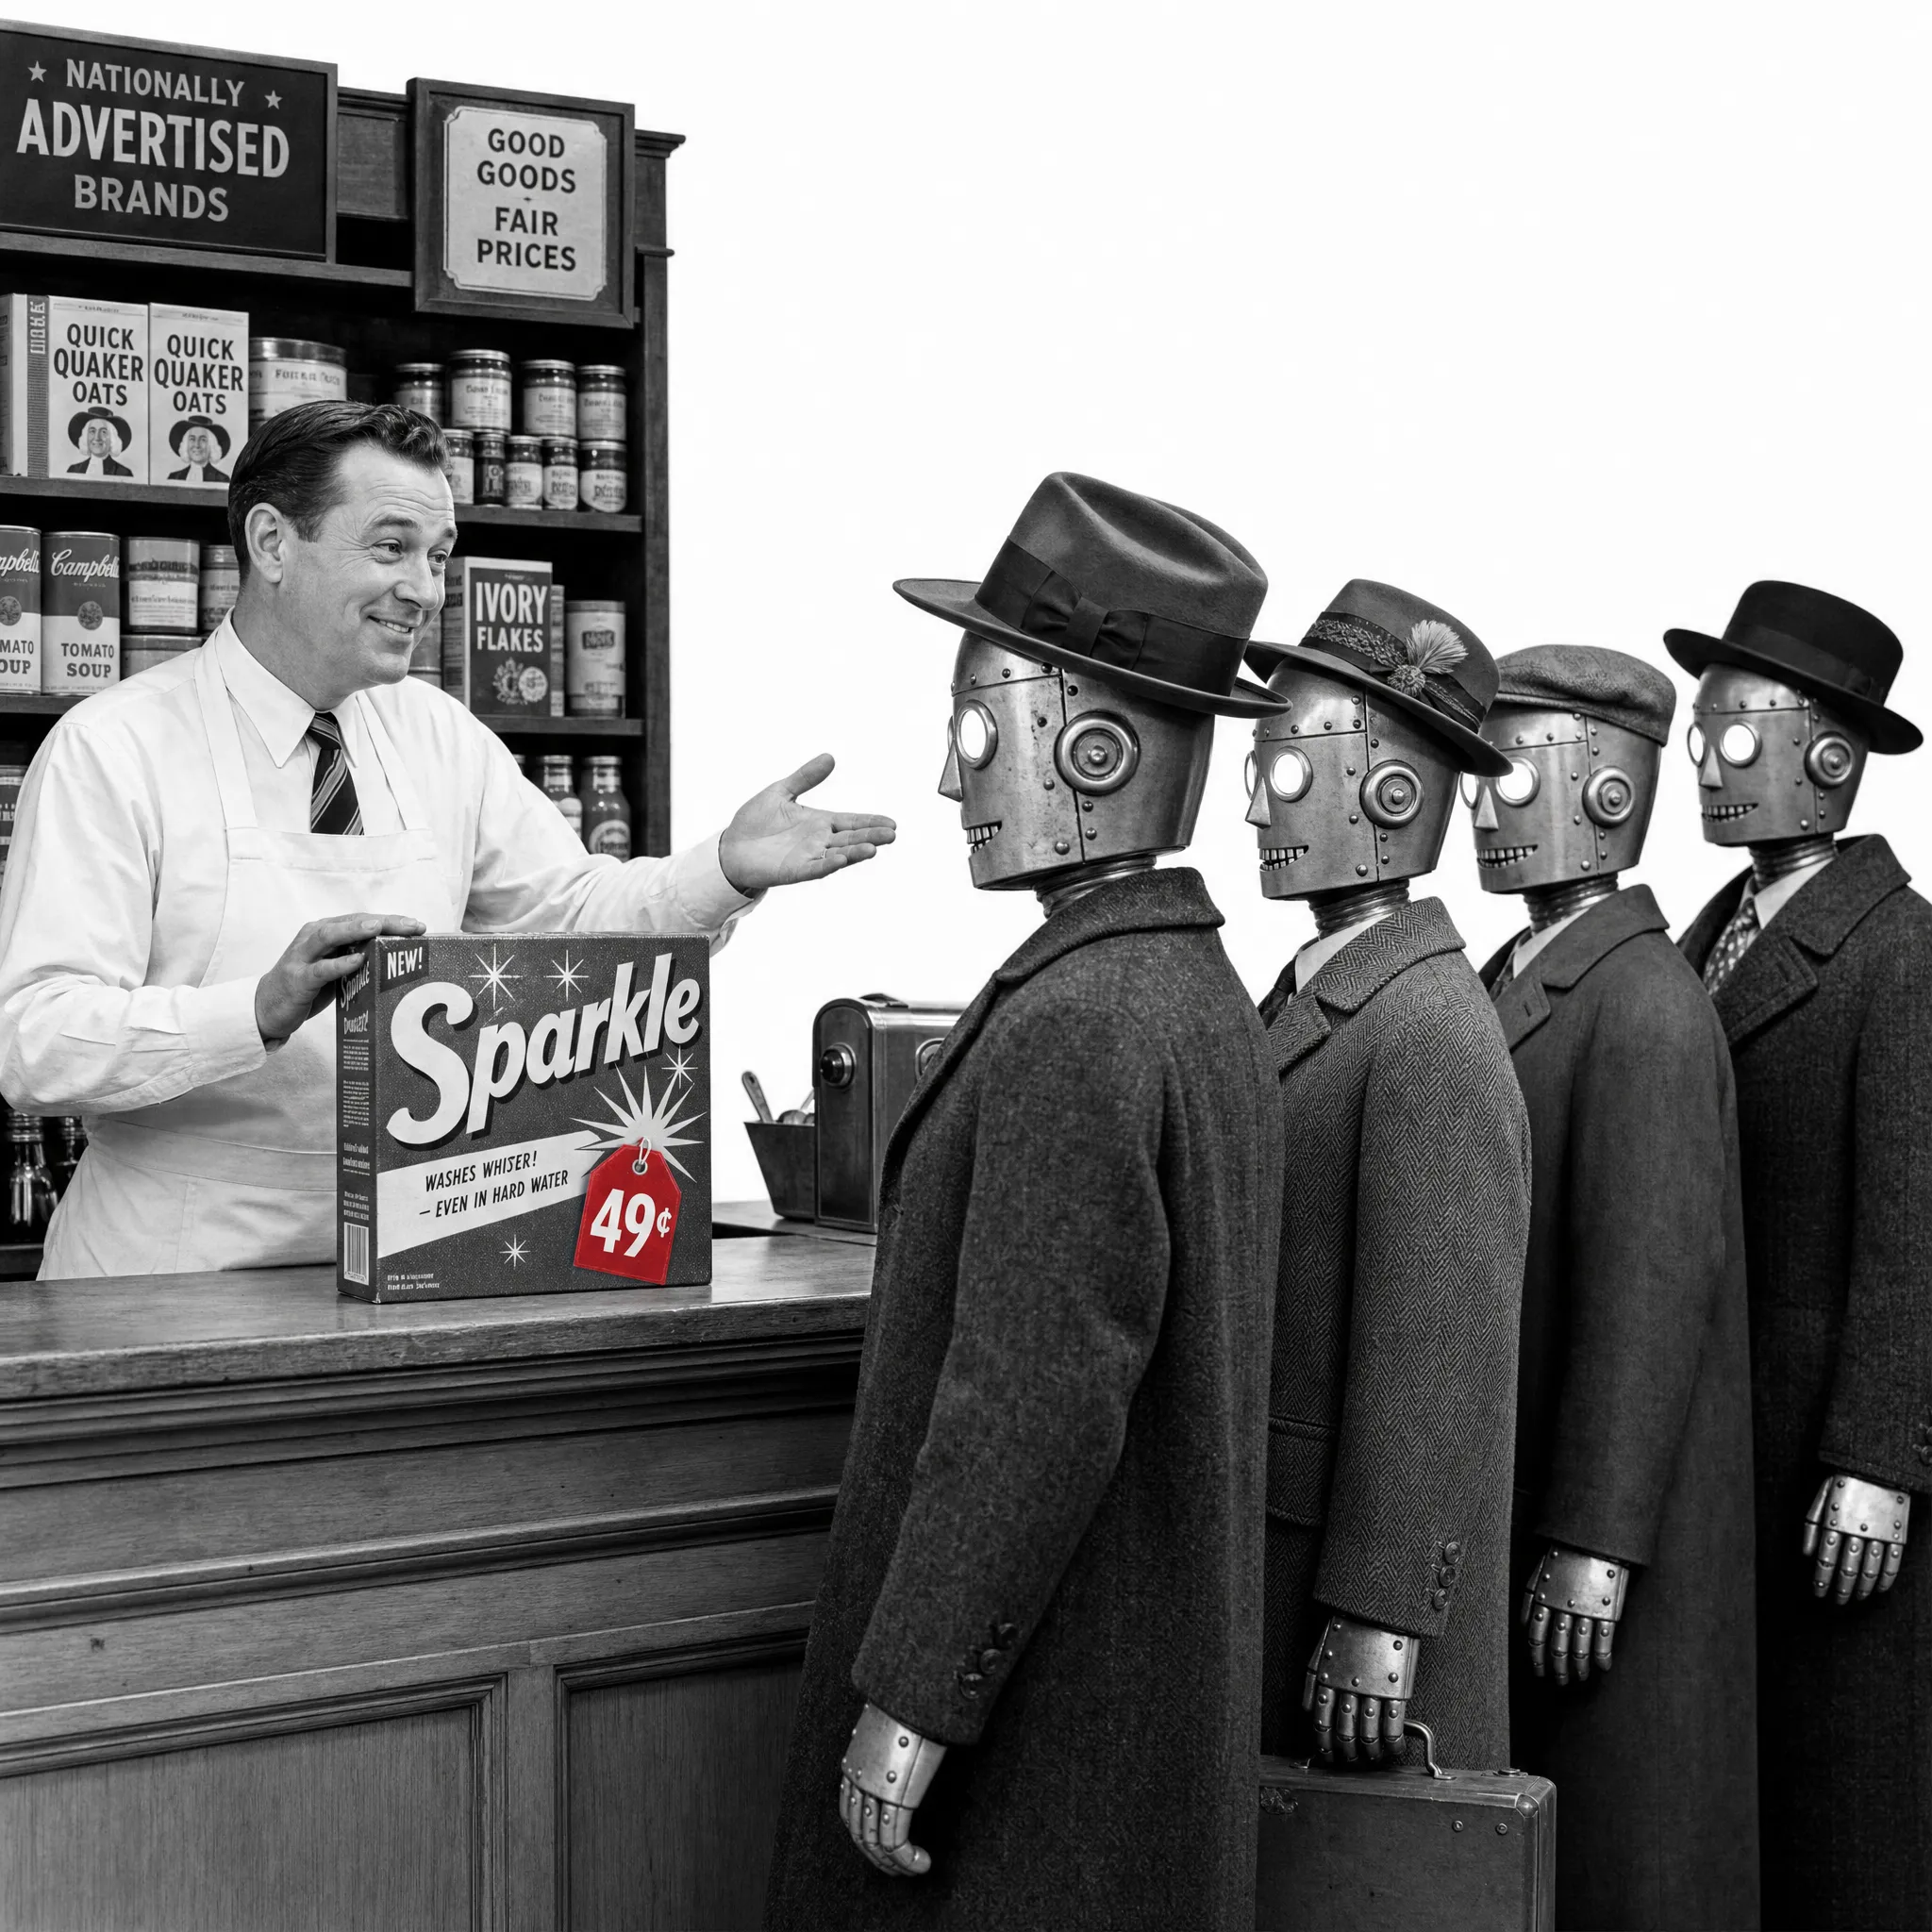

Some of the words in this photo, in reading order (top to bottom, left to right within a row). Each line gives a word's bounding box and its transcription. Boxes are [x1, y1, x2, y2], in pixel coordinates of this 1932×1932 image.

[66, 58, 245, 108] NATIONALLY
[17, 98, 290, 179] ADVERTISED
[487, 127, 565, 158] GOOD
[476, 160, 576, 194] GOODS
[75, 175, 228, 222] BRANDS
[494, 206, 558, 237] FAIR
[476, 238, 576, 272] PRICES
[67, 323, 134, 351] QUICK
[167, 334, 234, 360] QUICK
[53, 347, 143, 382] QUAKER
[154, 358, 243, 391] QUAKER
[73, 380, 127, 407] OATS
[173, 391, 226, 415] OATS
[475, 581, 548, 625] IVORY
[0, 639, 34, 655] MATO
[60, 642, 115, 658] TOMATO
[476, 626, 543, 653] FLAKES
[0, 658, 31, 675] OUP
[66, 662, 111, 678] SOUP
[387, 946, 424, 980] NEW!
[386, 952, 702, 1146] Sparkle
[425, 1165, 476, 1192] WASHES
[435, 1194, 469, 1218] EVEN
[474, 1190, 488, 1208] IN
[492, 1181, 525, 1204] HARD
[531, 1170, 569, 1193] WATER
[590, 1188, 673, 1258] 49¢
